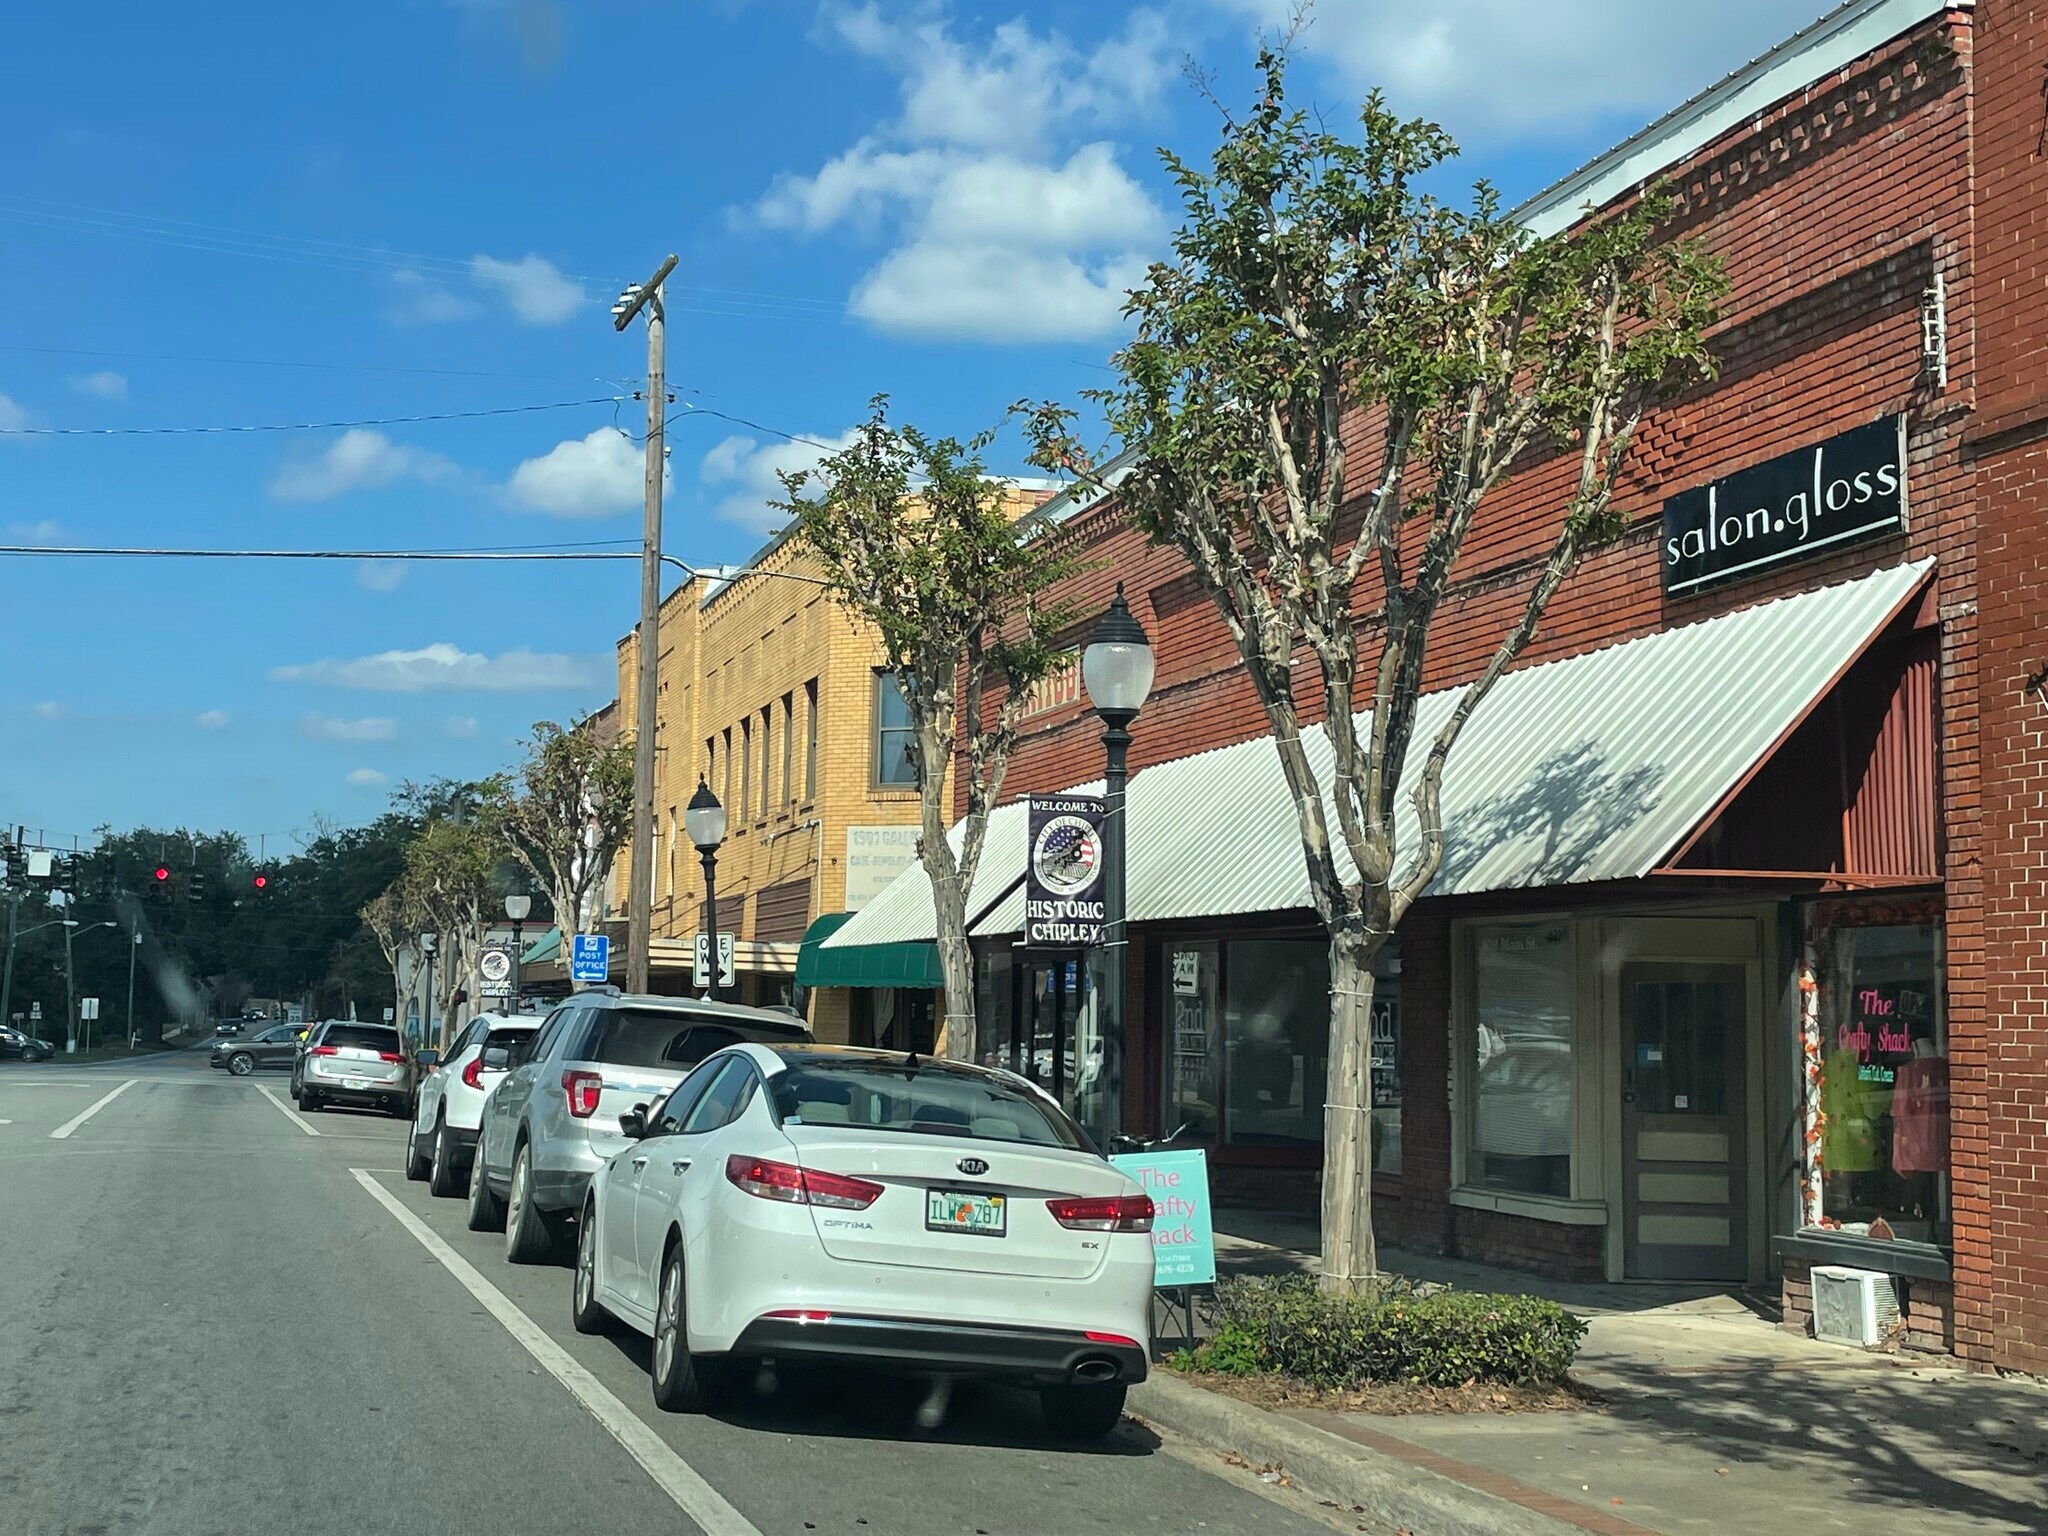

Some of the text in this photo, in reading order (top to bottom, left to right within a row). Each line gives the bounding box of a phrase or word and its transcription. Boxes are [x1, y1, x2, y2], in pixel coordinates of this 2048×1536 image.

[1667, 447, 1898, 565] salon.gloss
[1032, 800, 1105, 813] WELCOME TO
[1038, 824, 1054, 844] CITY
[1055, 817, 1066, 827] OF
[1028, 900, 1104, 919] HISTORIC
[1031, 923, 1103, 941] CHIPLEY
[700, 938, 727, 949] OE
[575, 961, 605, 969] OFFICE
[700, 953, 729, 964] WY
[1859, 989, 1894, 1015] The
[1839, 1021, 1911, 1062] Crafty Shack
[961, 1159, 985, 1173] KIA
[1136, 1168, 1180, 1189] The
[974, 1203, 1001, 1225] Z87
[1153, 1196, 1196, 1220] afty
[823, 1220, 874, 1230] OPTIMA
[1081, 1242, 1099, 1250] EX
